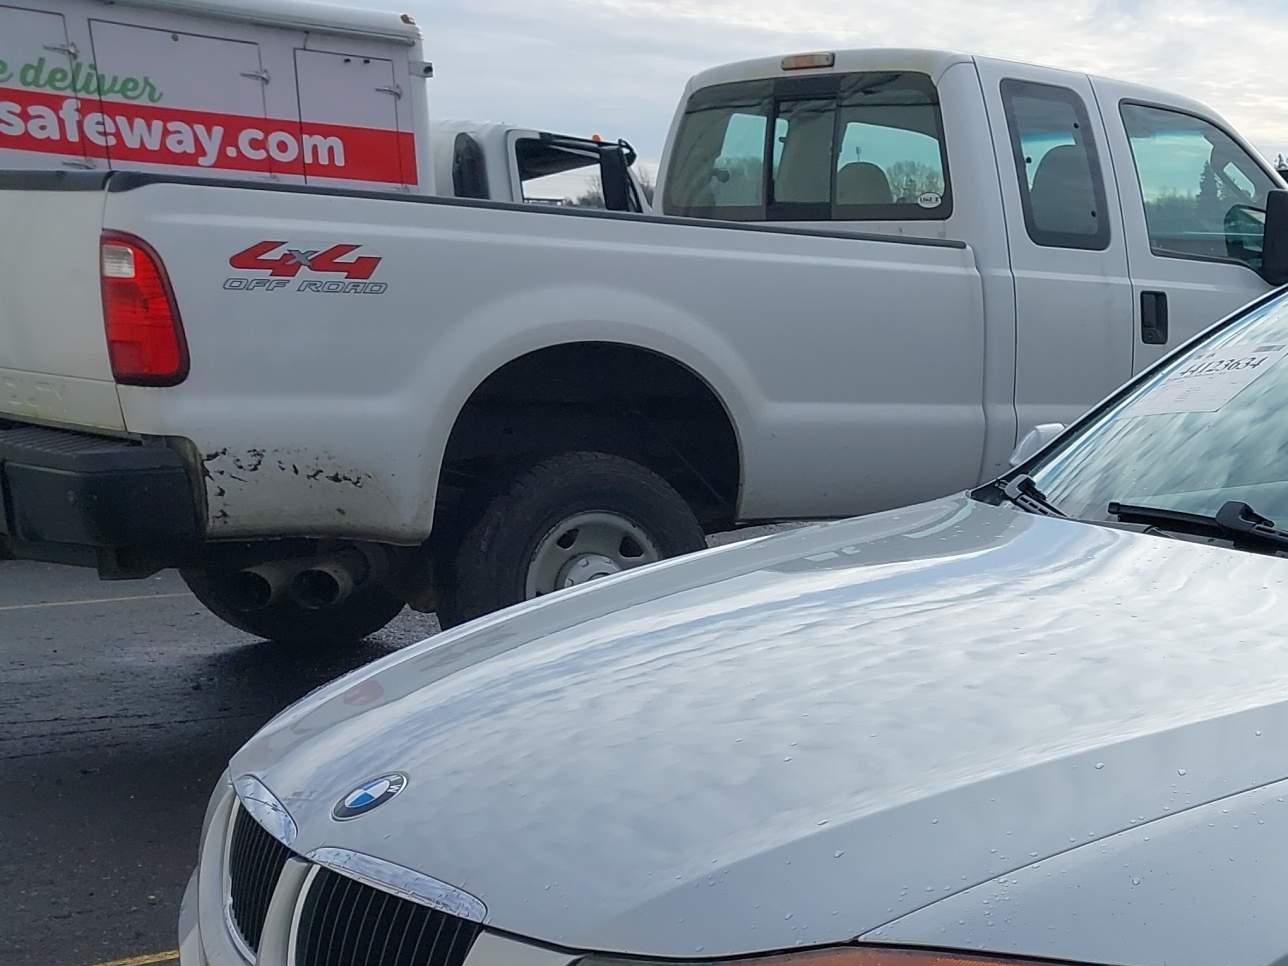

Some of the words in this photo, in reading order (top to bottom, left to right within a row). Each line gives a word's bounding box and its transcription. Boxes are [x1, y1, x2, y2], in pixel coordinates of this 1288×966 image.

[20, 57, 163, 103] deliver
[0, 98, 345, 167] safeway.com
[223, 278, 290, 291] OFF
[297, 280, 388, 295] ROAD
